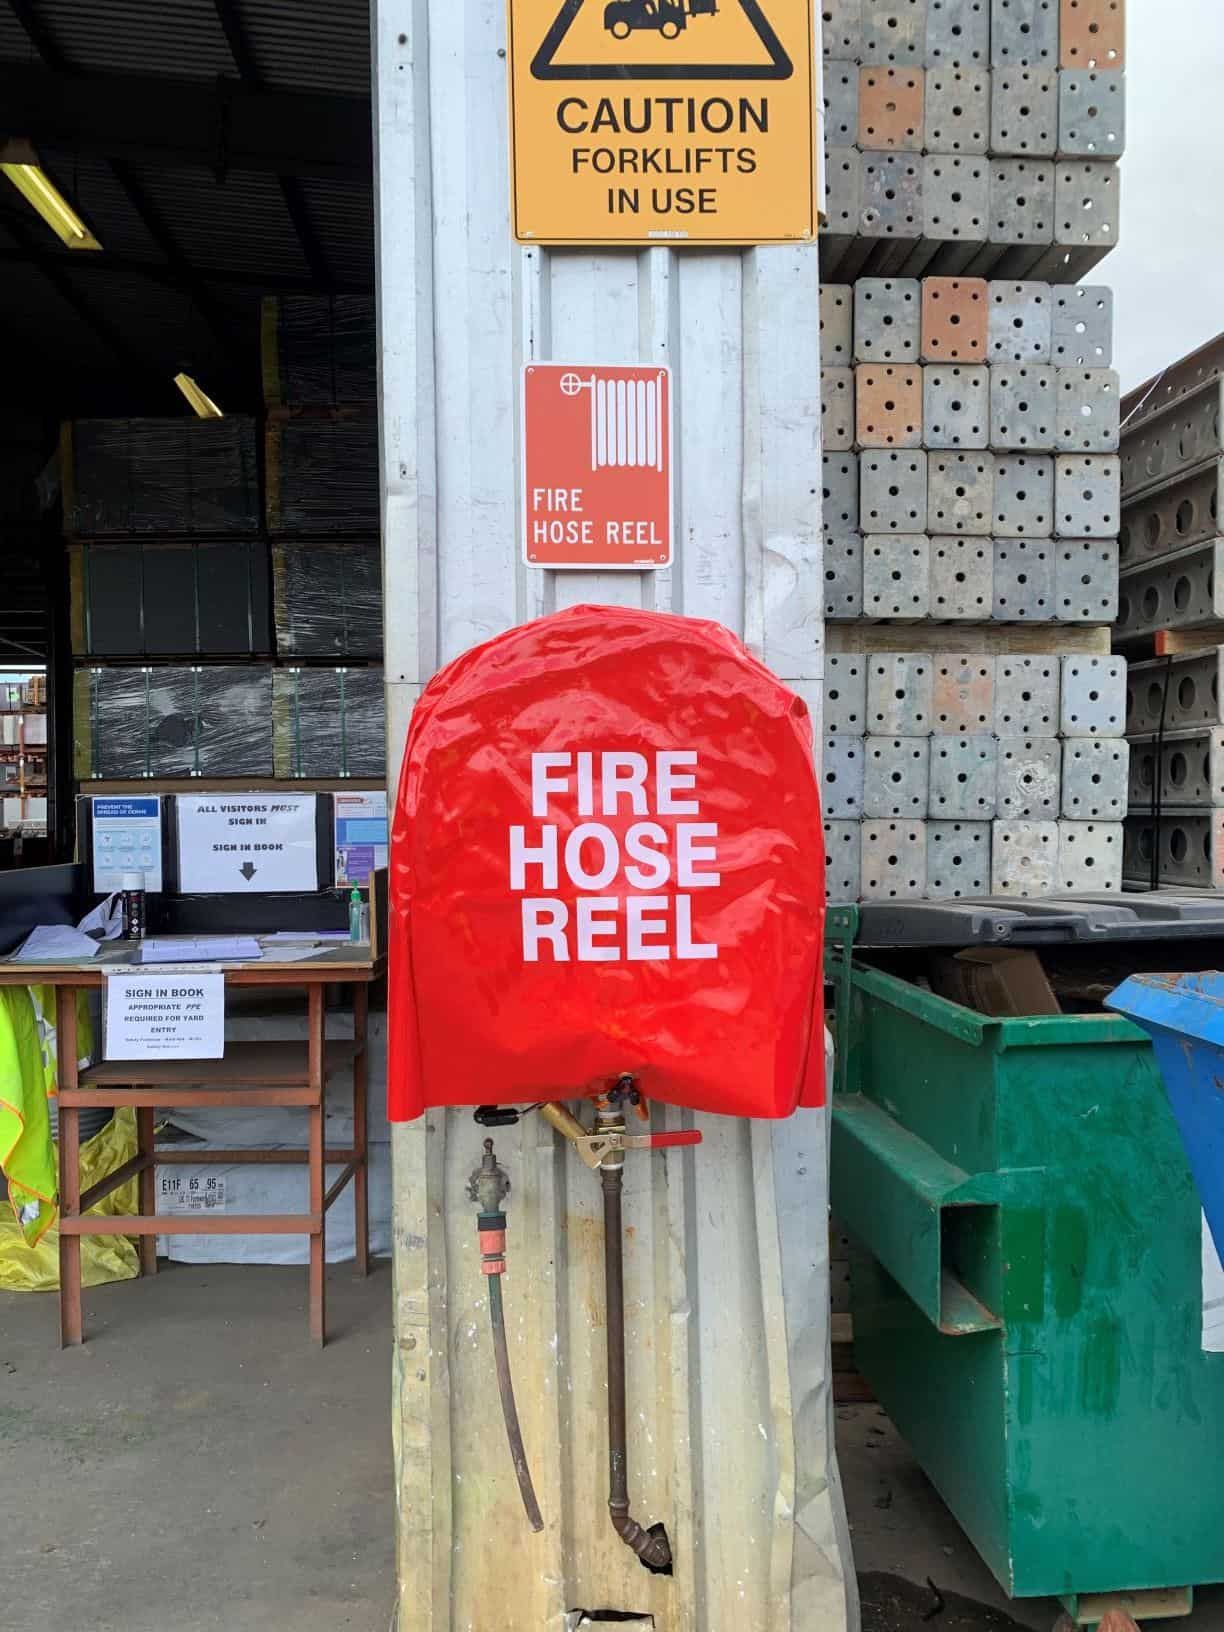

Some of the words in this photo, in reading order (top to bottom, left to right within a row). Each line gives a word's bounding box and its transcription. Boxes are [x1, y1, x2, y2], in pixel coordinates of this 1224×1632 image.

[556, 96, 769, 134] CAUTION
[572, 147, 757, 174] FORKLIFTS
[607, 188, 640, 214] IN
[651, 188, 718, 214] USE
[532, 487, 584, 512] FIRE
[533, 520, 594, 545] HOSE
[606, 521, 663, 545] REEL
[531, 750, 700, 817] FIRE
[197, 805, 218, 813] ALL
[220, 804, 267, 813] VISITORS
[228, 818, 253, 826] SIGN
[212, 843, 237, 851] SIGN
[240, 843, 251, 851] IN
[254, 843, 284, 851] BOOK
[509, 822, 721, 891] HOSE
[521, 894, 719, 962] REEL
[125, 988, 152, 998] SIGN
[155, 988, 168, 997] IN
[171, 988, 204, 997] BOOK
[162, 1179, 181, 1191] E11F
